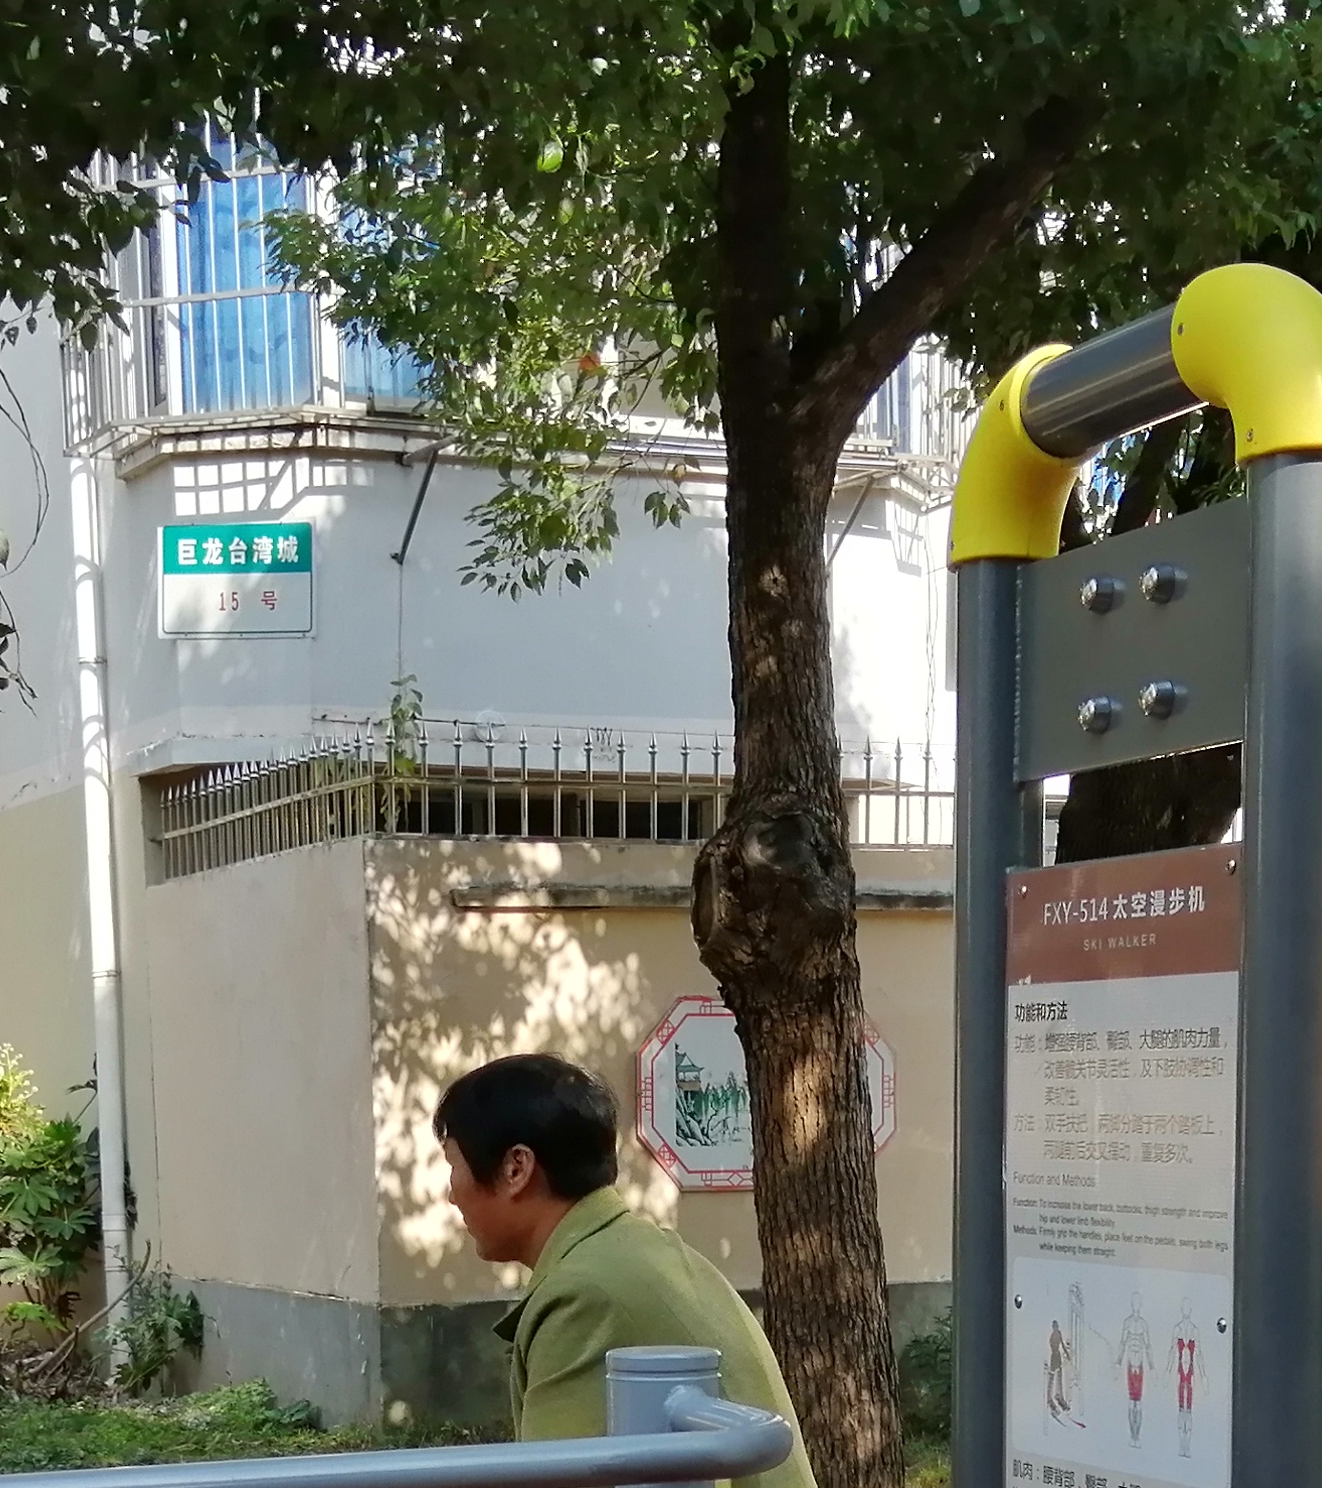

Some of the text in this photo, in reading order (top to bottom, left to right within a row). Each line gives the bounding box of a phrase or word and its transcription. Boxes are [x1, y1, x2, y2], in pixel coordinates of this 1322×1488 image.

[177, 535, 299, 566] 巨龙台湾城
[218, 591, 277, 612] 15 号
[1043, 884, 1205, 926] FXY-514 太空漫步机
[1083, 933, 1156, 951] SKI WALKER
[1015, 1001, 1067, 1022] 功能和方法
[1012, 1170, 1095, 1188] Function and Methods
